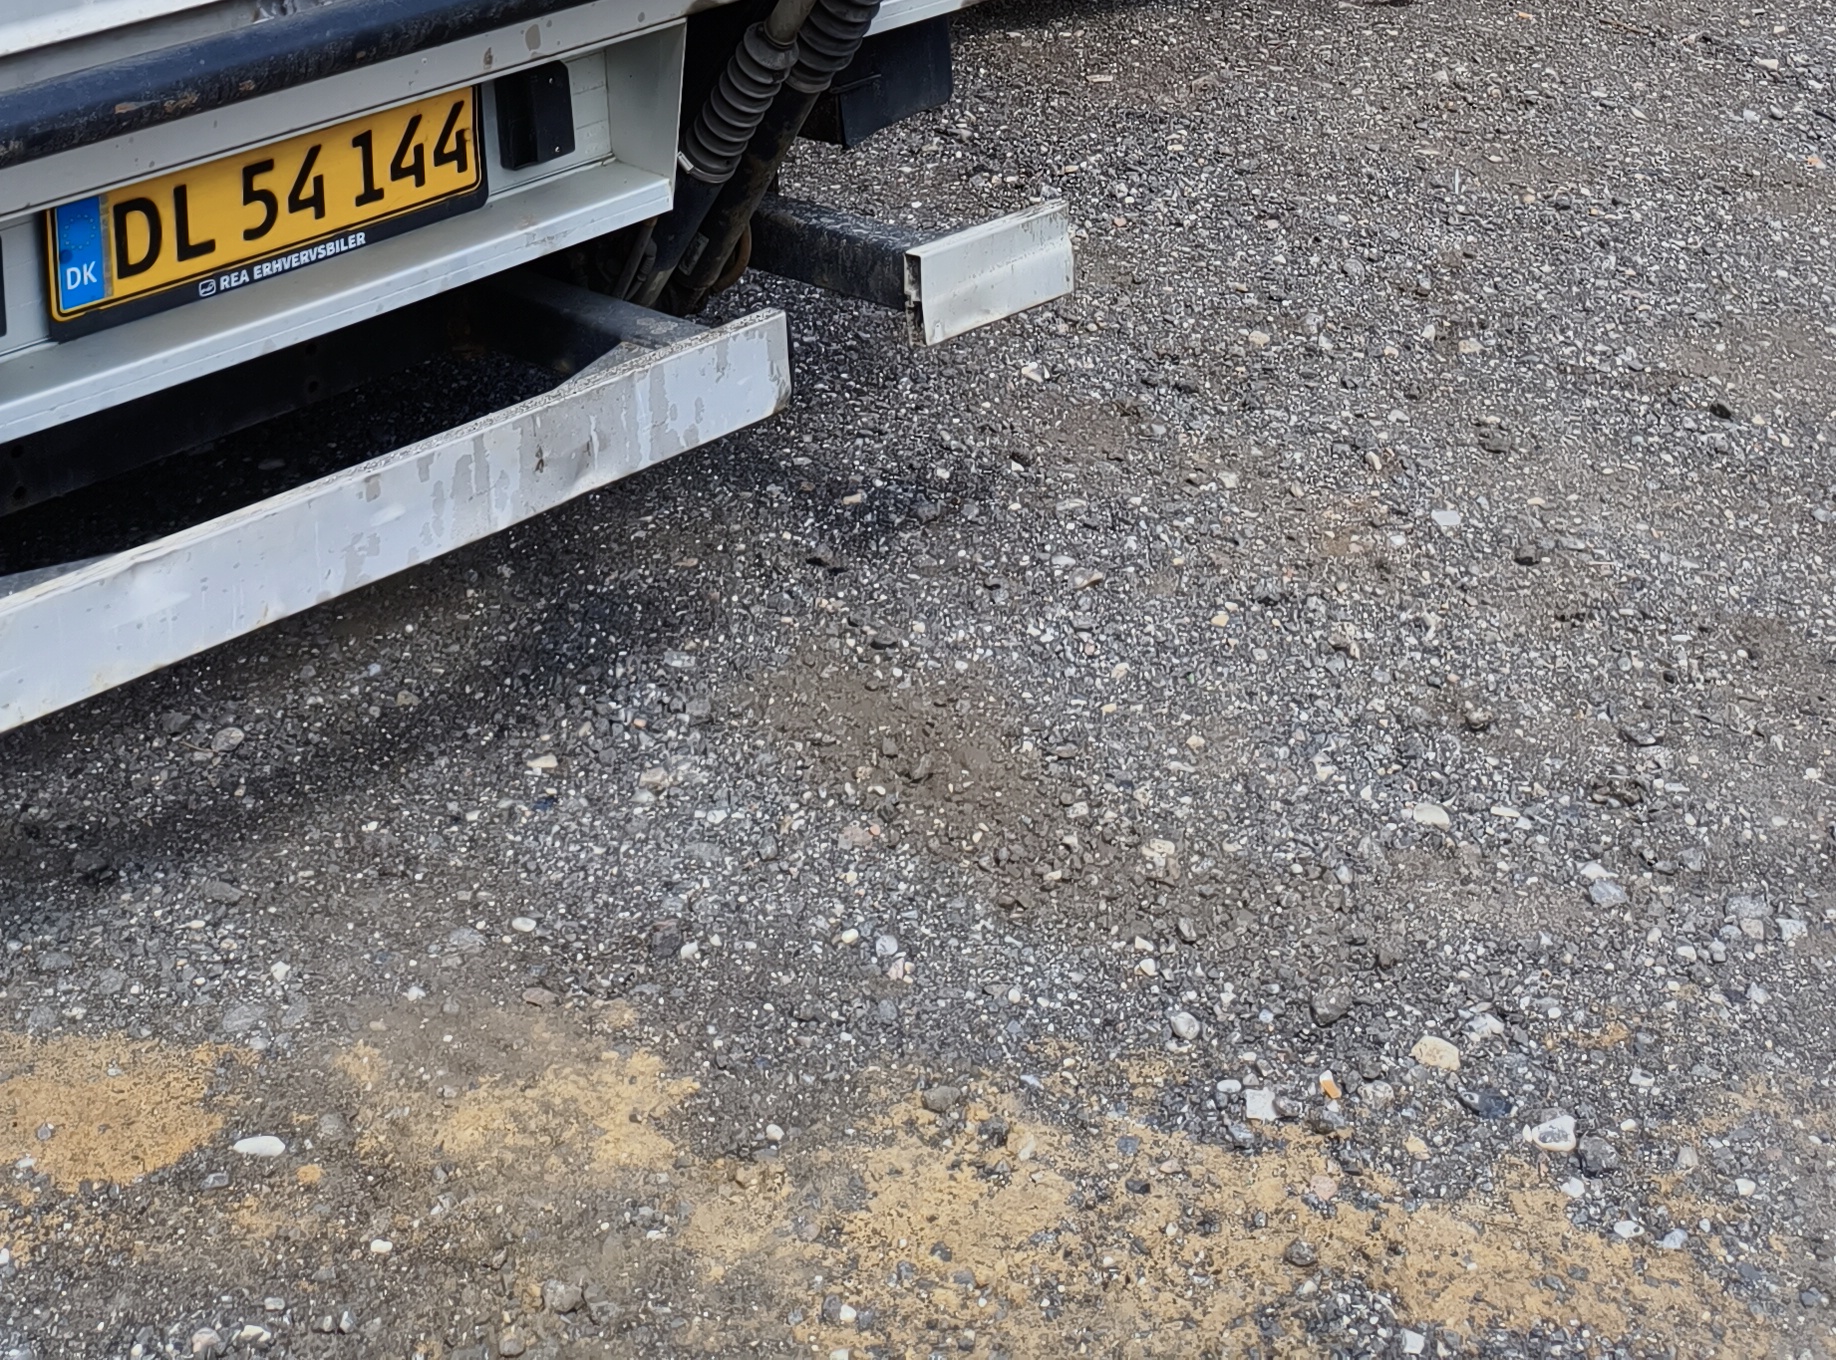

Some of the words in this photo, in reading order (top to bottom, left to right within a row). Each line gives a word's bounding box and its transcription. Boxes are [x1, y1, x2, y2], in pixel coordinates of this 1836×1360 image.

[112, 183, 217, 280] DL
[241, 143, 326, 241] 54
[351, 100, 470, 208] 144
[65, 260, 98, 291] DK
[219, 270, 251, 290] REA
[252, 231, 367, 281] ERHVERVSBILER
